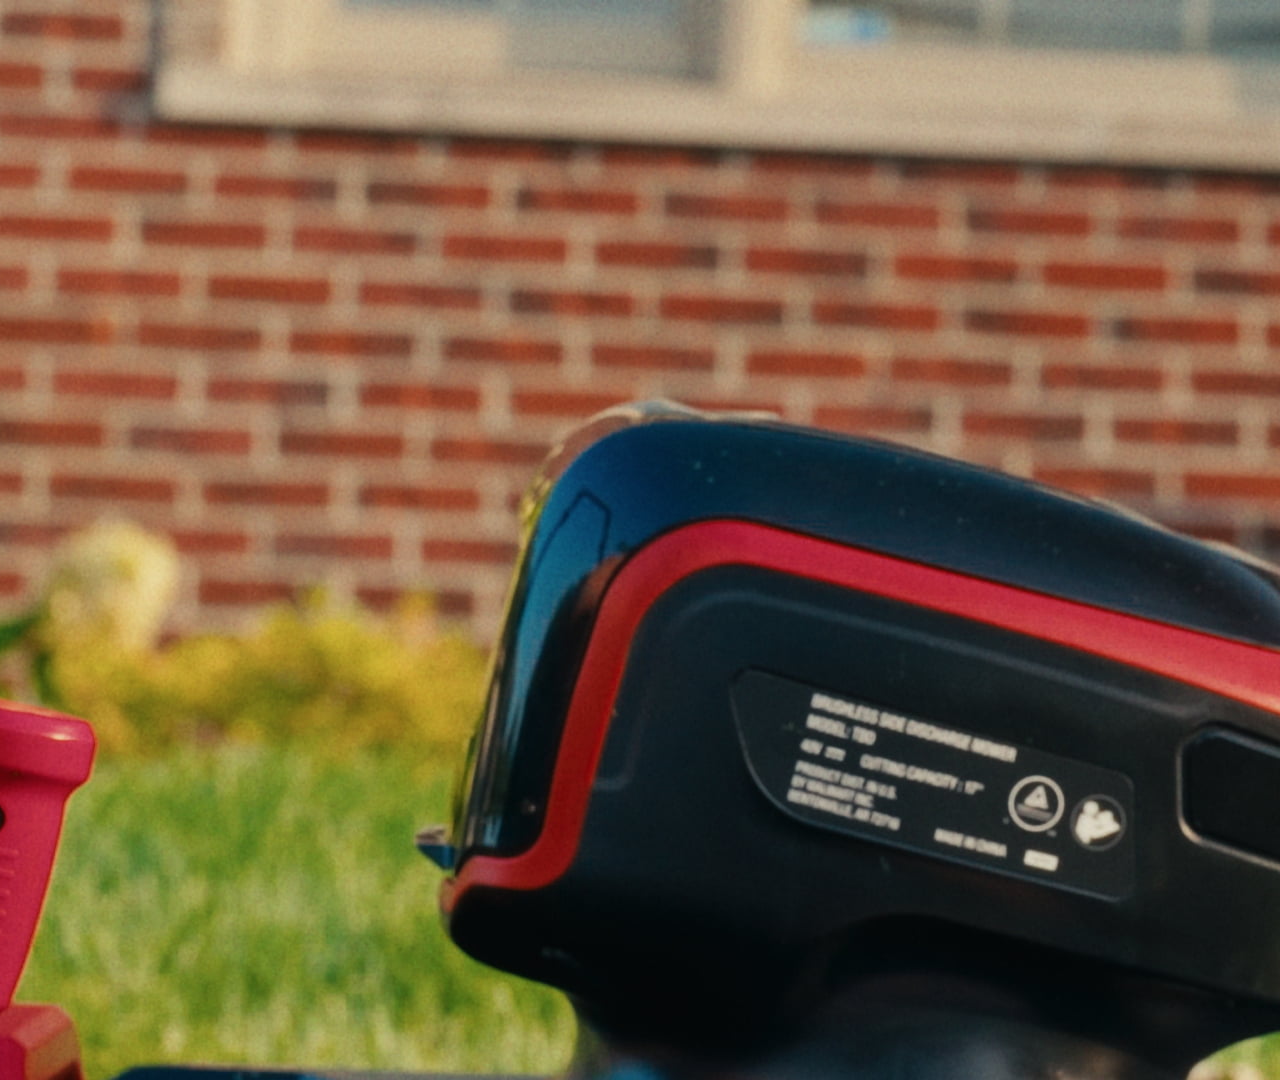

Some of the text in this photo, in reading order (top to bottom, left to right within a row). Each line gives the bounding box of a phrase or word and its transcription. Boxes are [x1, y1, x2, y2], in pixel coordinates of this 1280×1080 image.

[811, 693, 1017, 762] BRUSHLESS SIDE DISCHARGE MOWER
